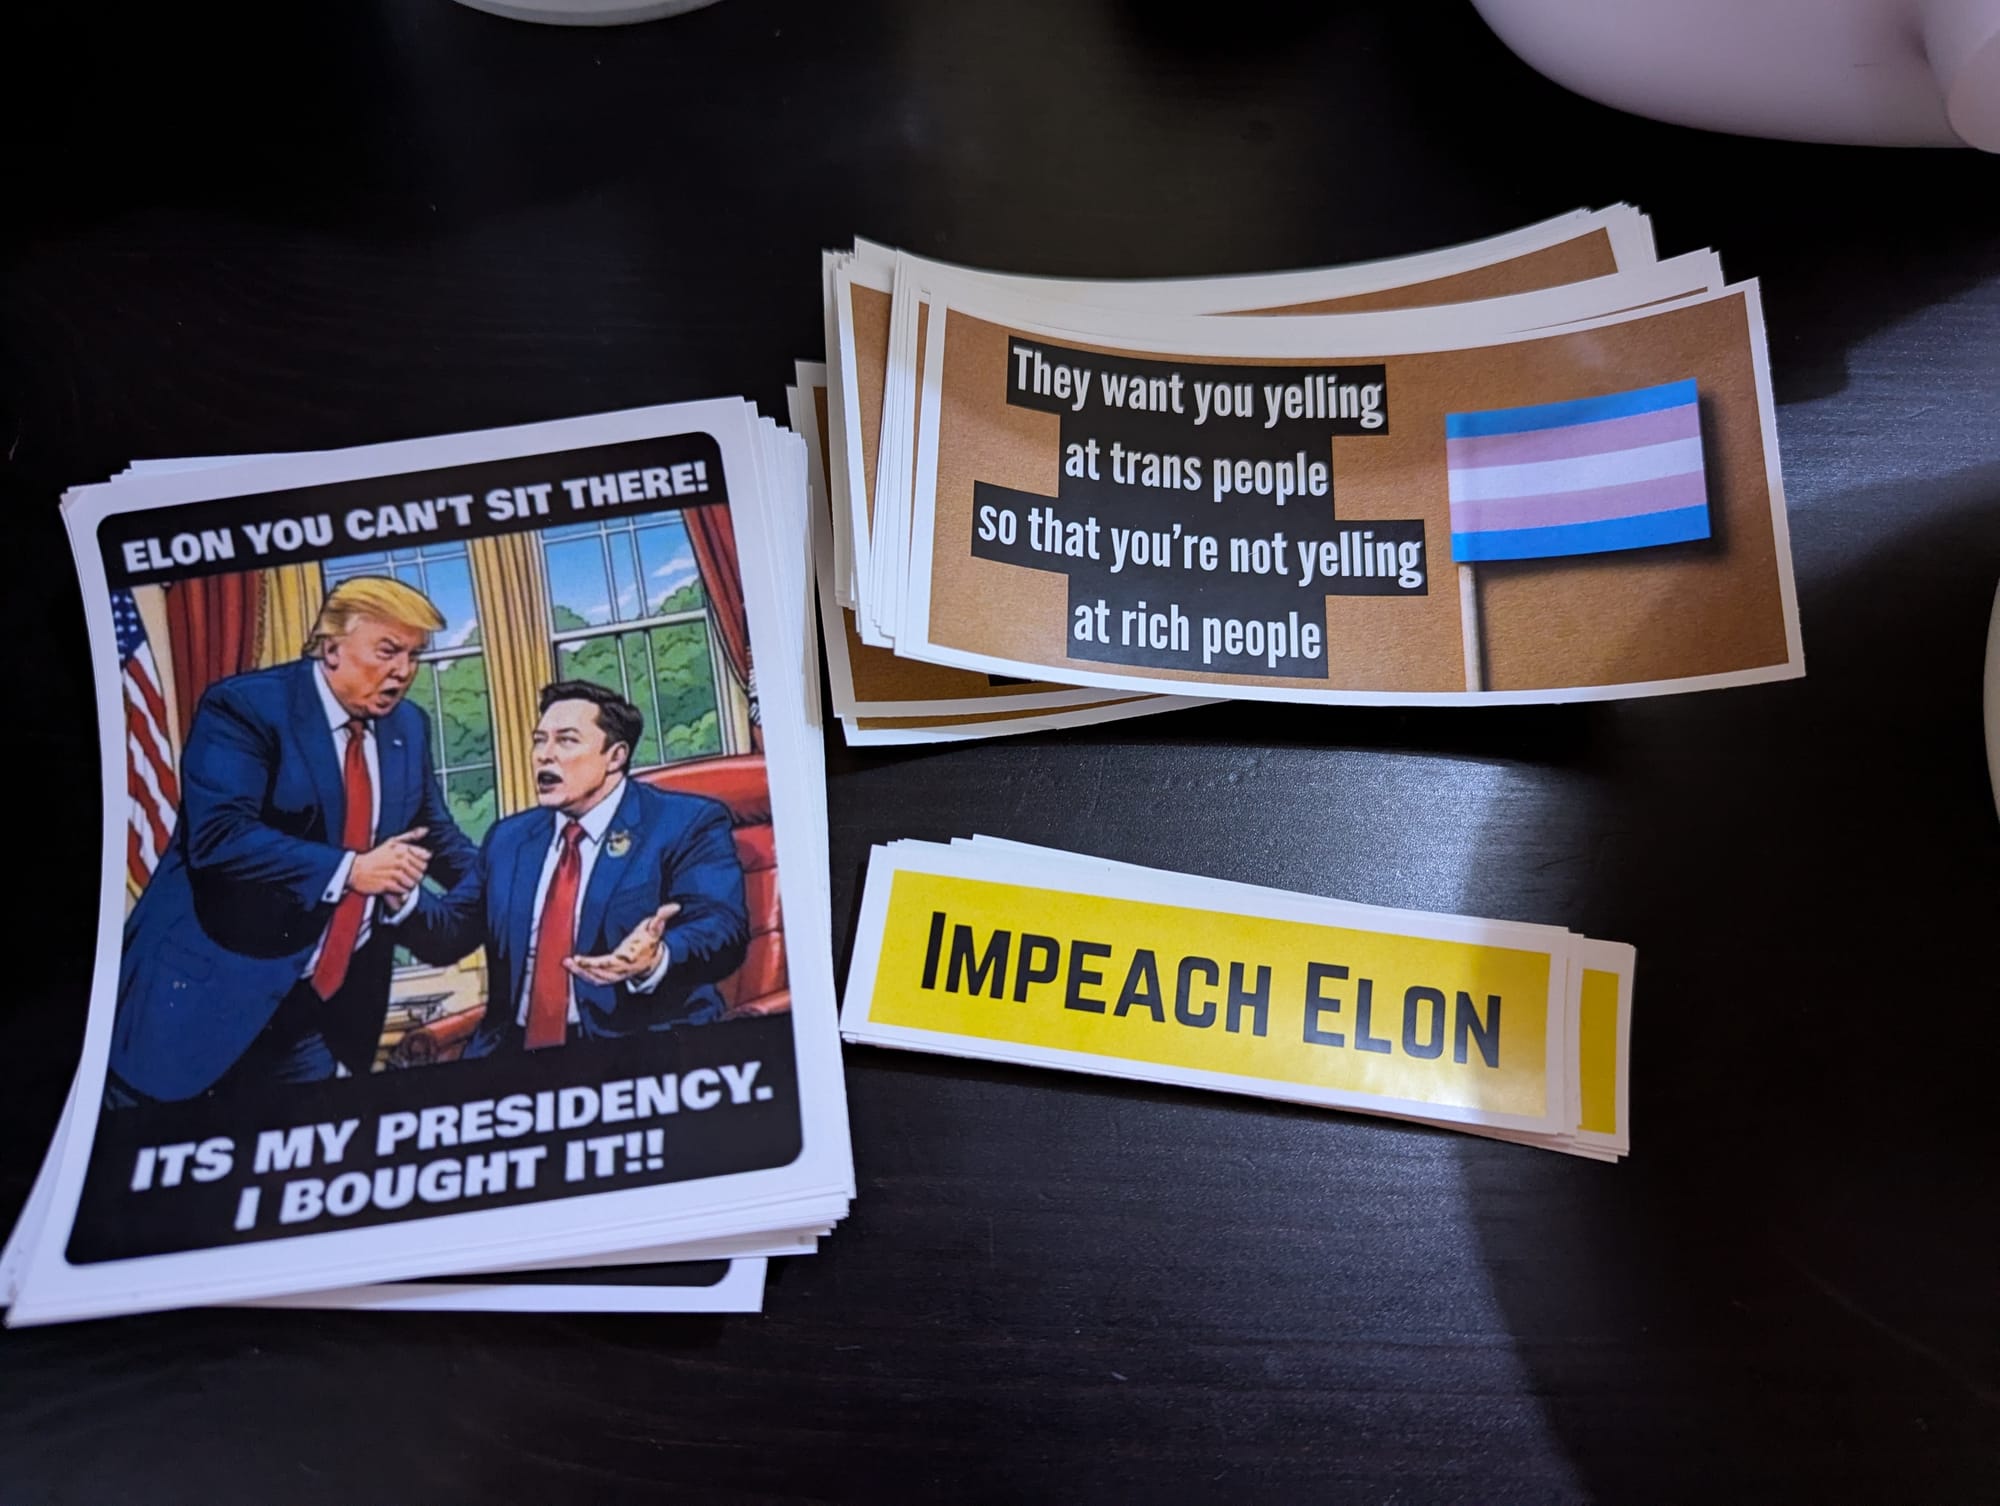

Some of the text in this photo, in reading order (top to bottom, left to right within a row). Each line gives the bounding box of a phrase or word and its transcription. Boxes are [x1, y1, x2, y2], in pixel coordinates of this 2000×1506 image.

[1012, 345, 1384, 429] They want you yelling
[1065, 438, 1329, 505] at trans people
[122, 461, 708, 572] ELON YOU CAN'T SIT THERE!
[978, 504, 1421, 588] so that you're not yelling
[1074, 600, 1321, 668] at rich people
[130, 1060, 774, 1192] ITS MY PRESIDENCY.
[232, 1128, 666, 1231] I BOUGHT IT!!
